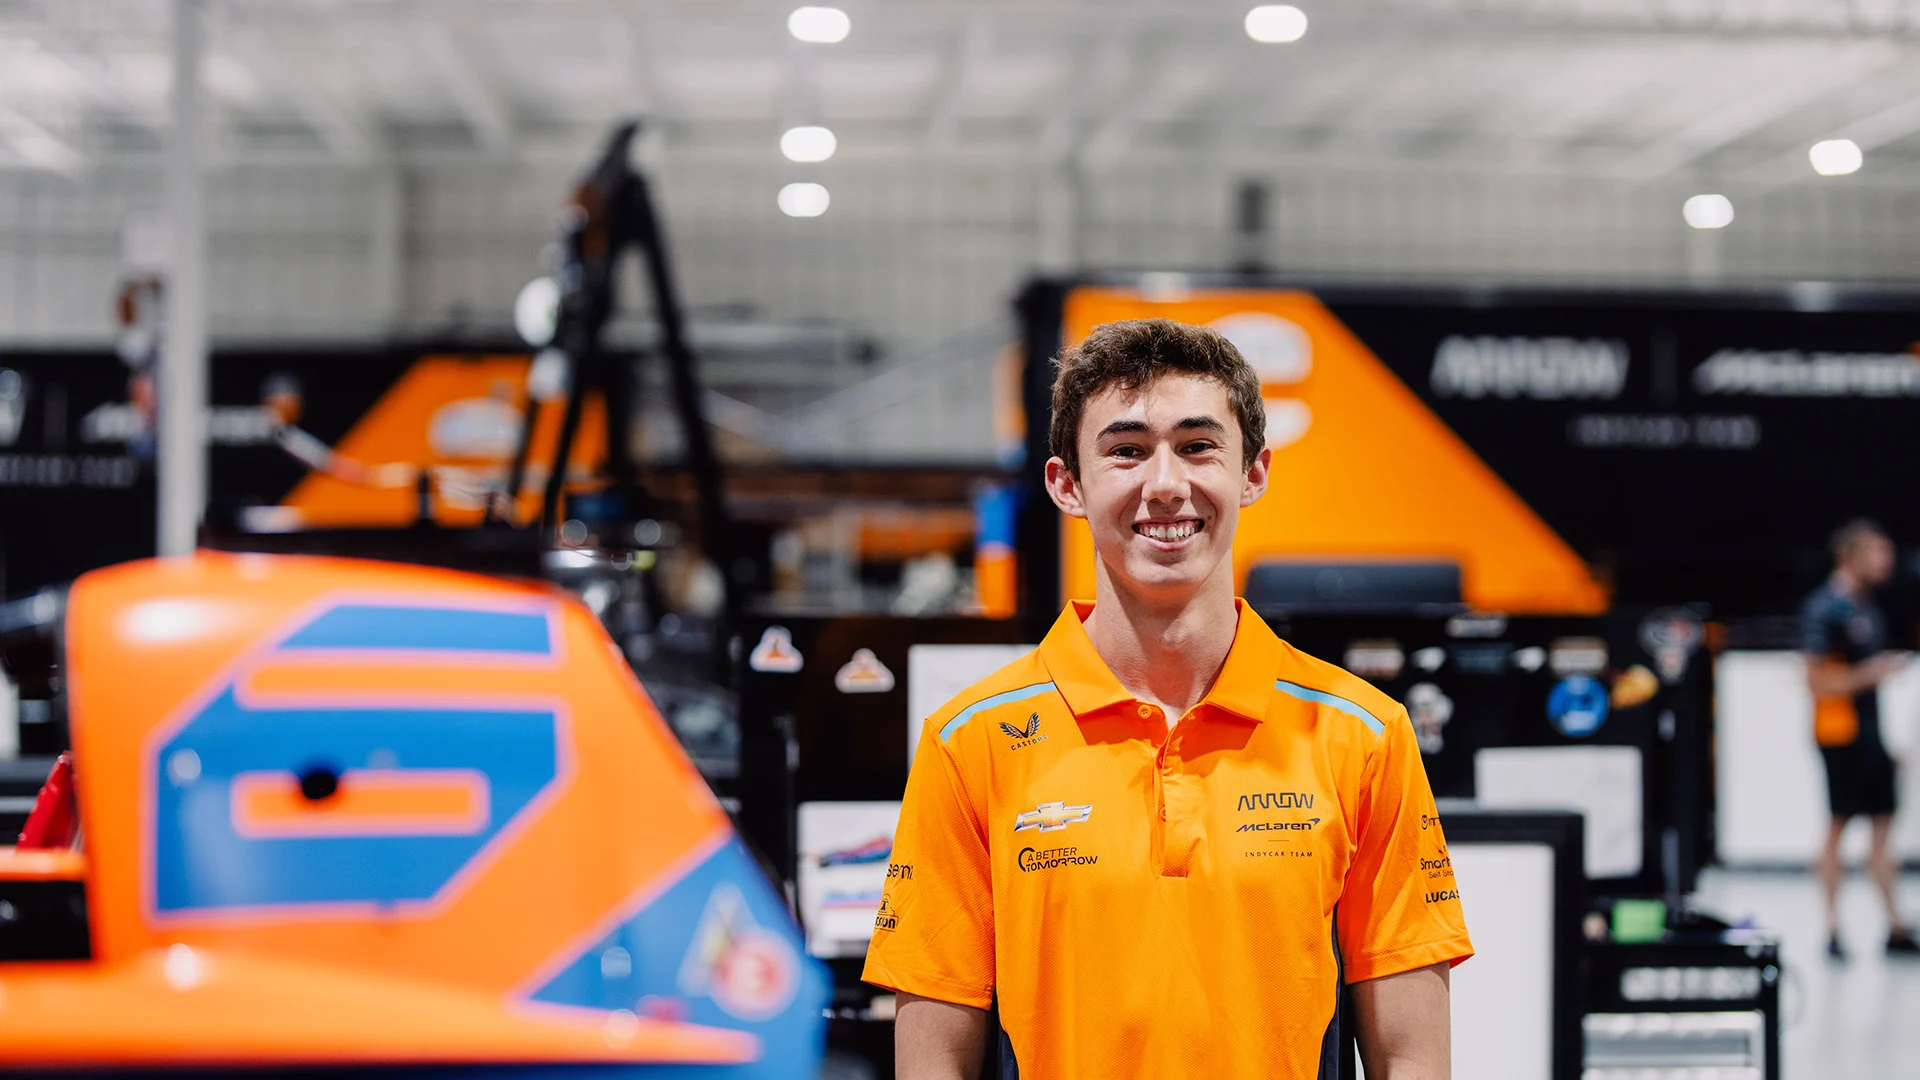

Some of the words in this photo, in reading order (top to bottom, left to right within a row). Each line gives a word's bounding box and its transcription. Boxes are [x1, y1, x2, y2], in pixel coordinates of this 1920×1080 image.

[1011, 734, 1048, 751] CASTORE
[143, 590, 571, 929] 6
[1237, 792, 1314, 811] ARROW
[1236, 821, 1313, 832] McLaren
[1026, 855, 1098, 872] TOMORROW
[1027, 853, 1034, 863] A
[1036, 847, 1077, 861] BETTER
[1420, 856, 1451, 870] Smart
